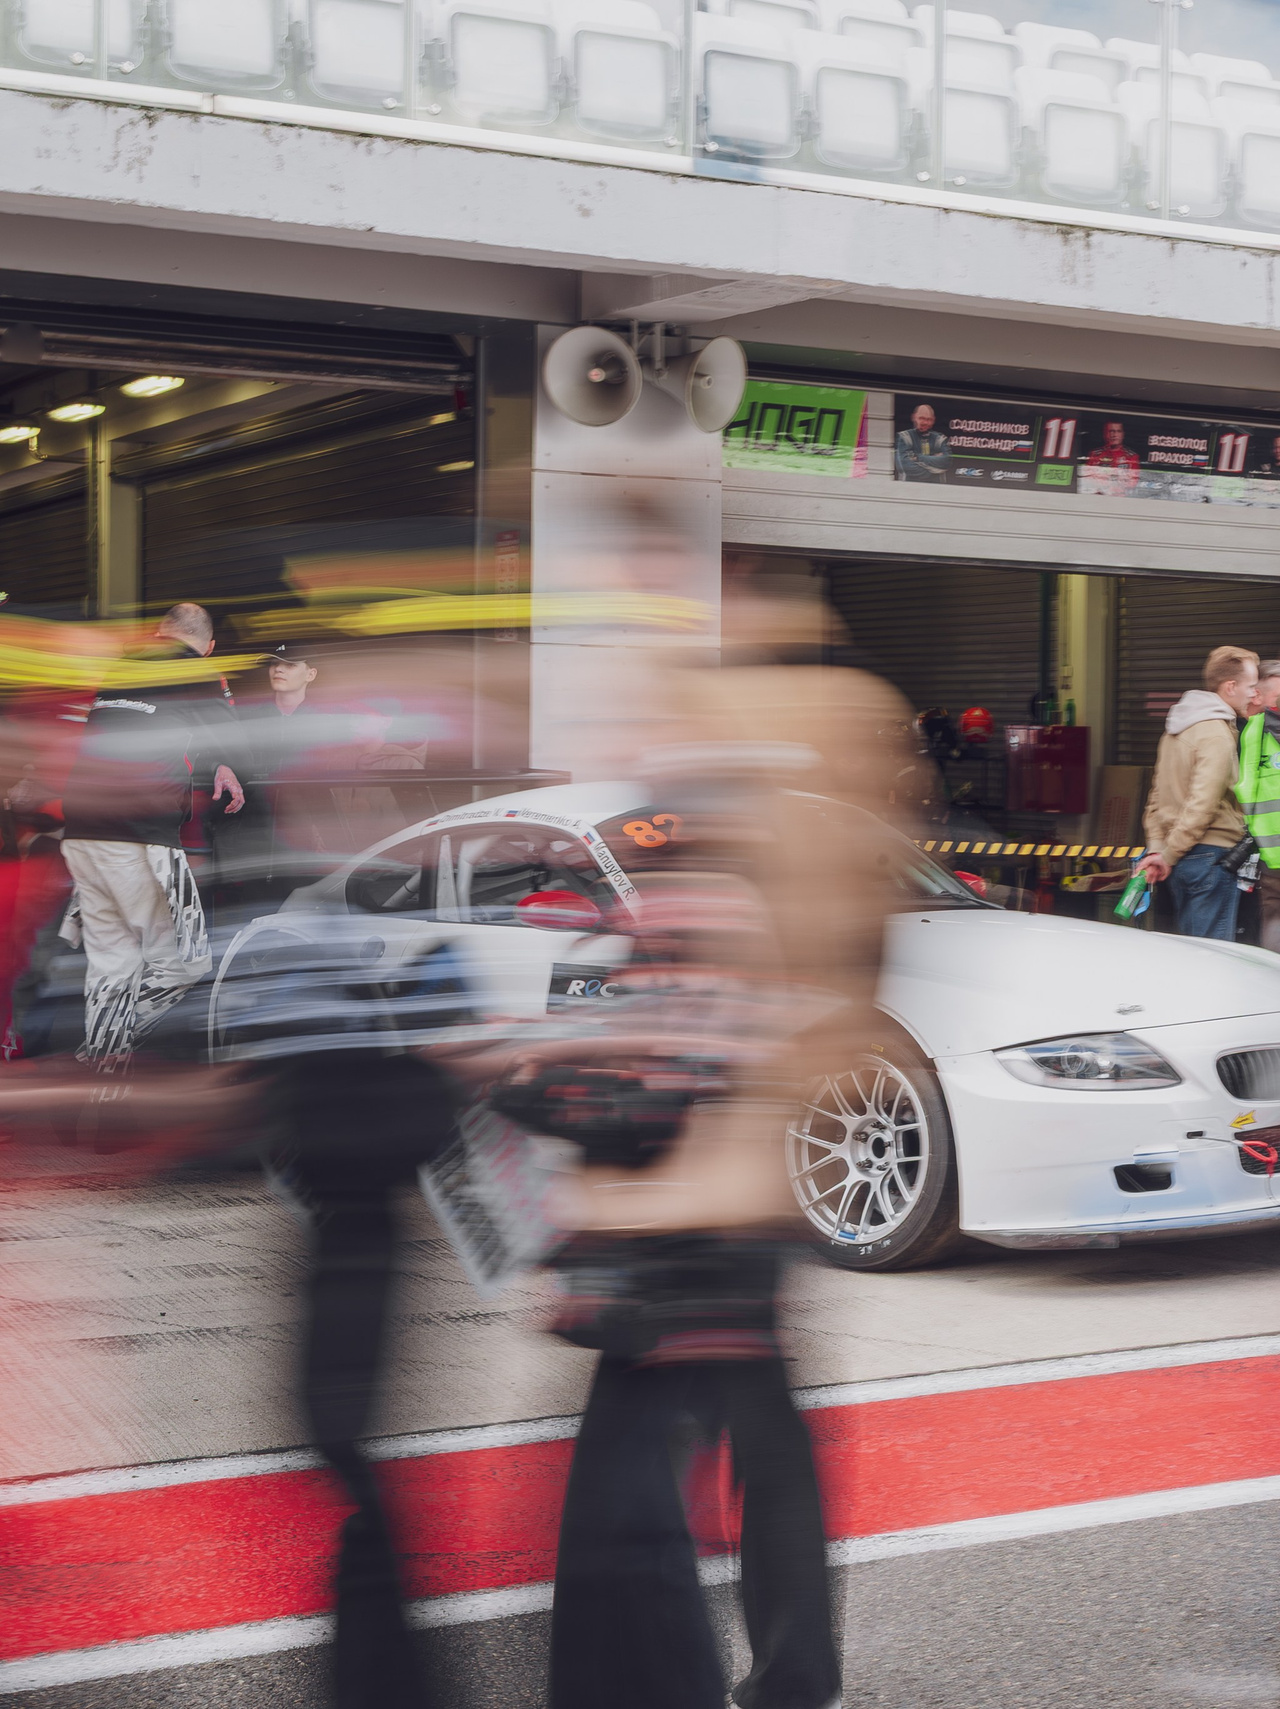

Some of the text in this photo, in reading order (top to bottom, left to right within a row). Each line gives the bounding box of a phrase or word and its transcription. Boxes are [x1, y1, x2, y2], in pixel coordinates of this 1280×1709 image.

[950, 419, 1030, 435] САДОВНИКОВ
[950, 436, 1019, 452] АЛЕКСАНДР
[1043, 418, 1077, 459] 11
[1148, 435, 1208, 452] ВСЕВОЛОД
[1148, 451, 1195, 465] ПРАХОВ
[1217, 432, 1250, 473] 11
[594, 841, 628, 888] Manuylov
